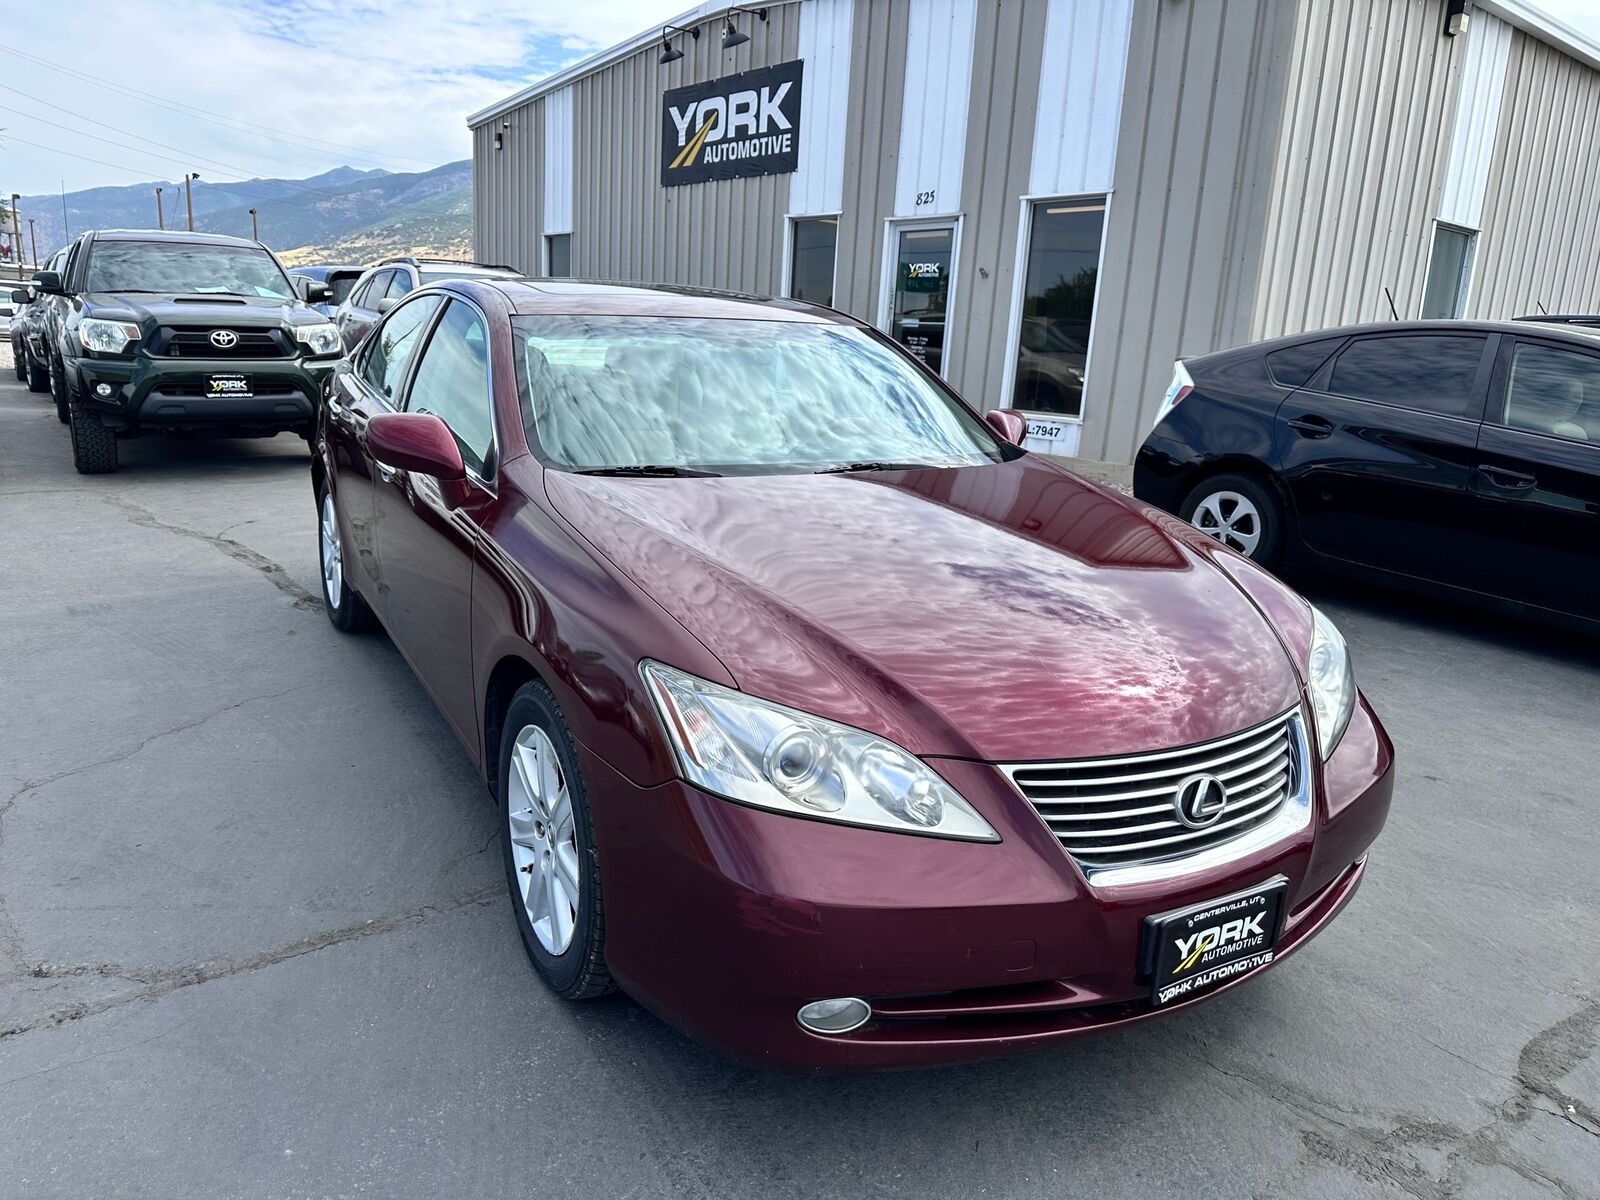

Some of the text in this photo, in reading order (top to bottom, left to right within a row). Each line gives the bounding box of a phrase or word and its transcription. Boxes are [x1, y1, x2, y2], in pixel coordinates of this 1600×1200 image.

[668, 81, 793, 147] YORK
[703, 133, 792, 164] AUTOMOTIVE
[916, 190, 935, 205] 825
[909, 262, 940, 273] YORK
[209, 380, 247, 388] YORK
[1194, 896, 1261, 922] CENTERVILLE, UT
[1174, 910, 1267, 960] YORK
[1201, 934, 1264, 963] AUTOMOTIVE
